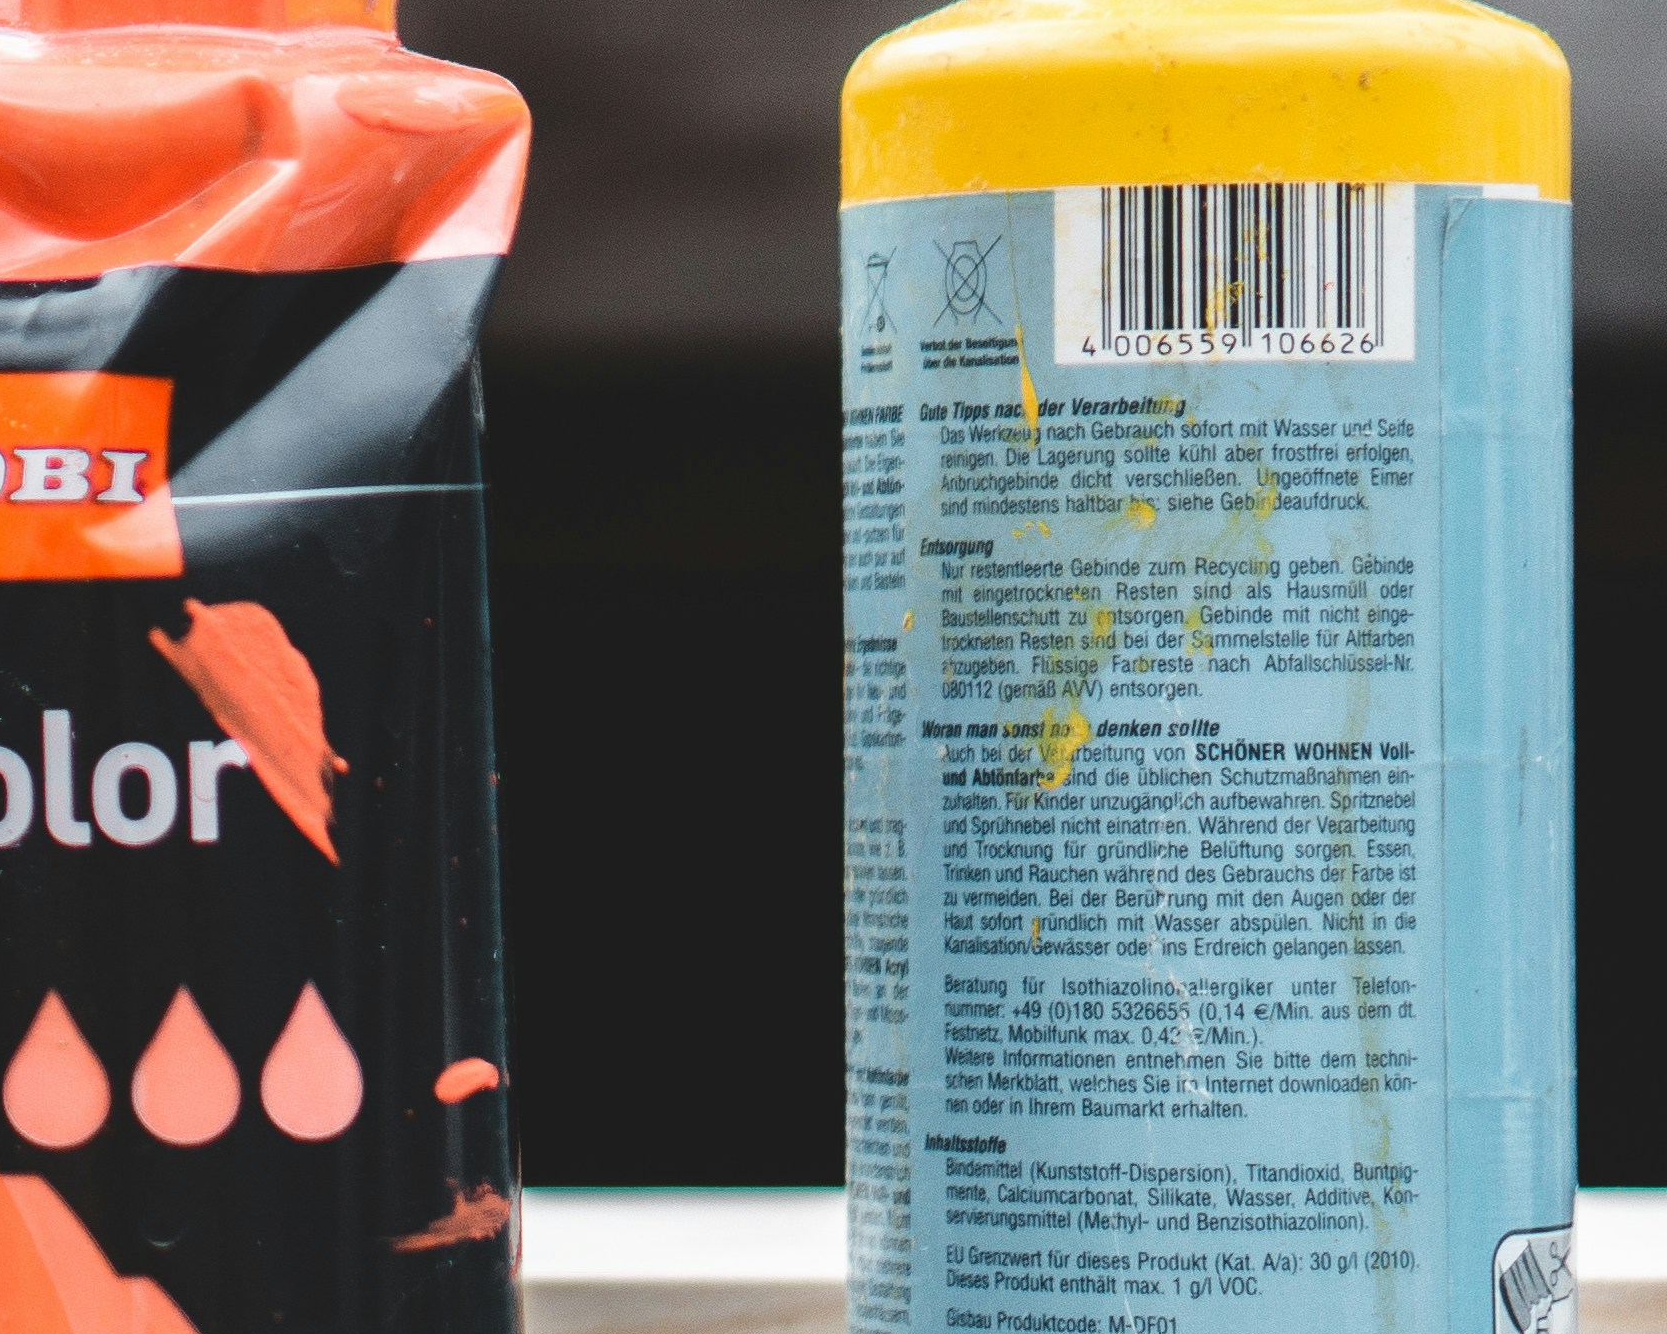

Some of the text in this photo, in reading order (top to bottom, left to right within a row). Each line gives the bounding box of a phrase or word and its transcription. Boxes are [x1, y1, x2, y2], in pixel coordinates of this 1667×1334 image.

[1082, 332, 1375, 358] 4 006559 106626
[919, 397, 1187, 424] Gute Tipps der Verarbeitung
[940, 418, 1415, 445] Das nach Gebrauch sofort mit Wasser und Seife
[1004, 446, 1031, 467] Die
[1036, 443, 1116, 470] Lagerung
[1123, 445, 1171, 465] sollte
[1178, 443, 1217, 463] kühl
[1223, 444, 1265, 464] aber
[1270, 443, 1339, 462] frostfrei
[1345, 443, 1414, 466] erfolgen,
[940, 466, 1414, 494] Anbruchgebinde dicht verschließen. Eimer
[919, 537, 995, 561] Entsorgung
[1069, 553, 1415, 580] Gebinde zum Recycling geben. Gebinde
[941, 580, 1415, 606] mit eingetrockneten Resten sind als Hausmüll oder
[1031, 653, 1415, 679] Flüssige Farbreste nach Abfallschlüssel-Nr.
[920, 718, 1221, 740] Woran man denken sollte
[981, 739, 1416, 764] bei der von SCHÖNER WOHNEN Voll-
[971, 815, 1416, 841] Sprühnebel nicht Während der Verarbeitung
[1021, 976, 1417, 997] für unter Telefon-
[1011, 1000, 1042, 1020] +49
[1047, 1001, 1105, 1024] (0)180
[1197, 1001, 1246, 1025] (0,14
[1253, 1001, 1314, 1021] €/Min.
[1320, 1004, 1351, 1021] aus
[1357, 1001, 1392, 1020] dem
[1008, 1024, 1135, 1045] Mobilfunk max.
[1002, 1047, 1418, 1071] Informationen entnehmen Sie bitte dem techni-
[923, 1133, 1008, 1155] Inhaltsstoffe
[1029, 1161, 1237, 1186] (Kunststoff-Dispersion),
[1352, 1161, 1419, 1185] Buntpig-
[997, 1183, 1138, 1209] Calciumcarbonat,
[1147, 1187, 1217, 1209] Silikate,
[1383, 1186, 1420, 1206] Kon-
[1156, 1212, 1370, 1232] und Benzisothiazolinon).
[1047, 1250, 1071, 1270] für
[1075, 1251, 1131, 1272] dieses
[1137, 1251, 1208, 1272] Produkt
[1214, 1252, 1256, 1276] (Kat.
[1261, 1252, 1303, 1275] A/a):
[1309, 1251, 1332, 1271] 30
[1337, 1251, 1358, 1275] g/l
[1364, 1250, 1420, 1274] (2010).
[996, 1310, 1102, 1334] Produktcode:
